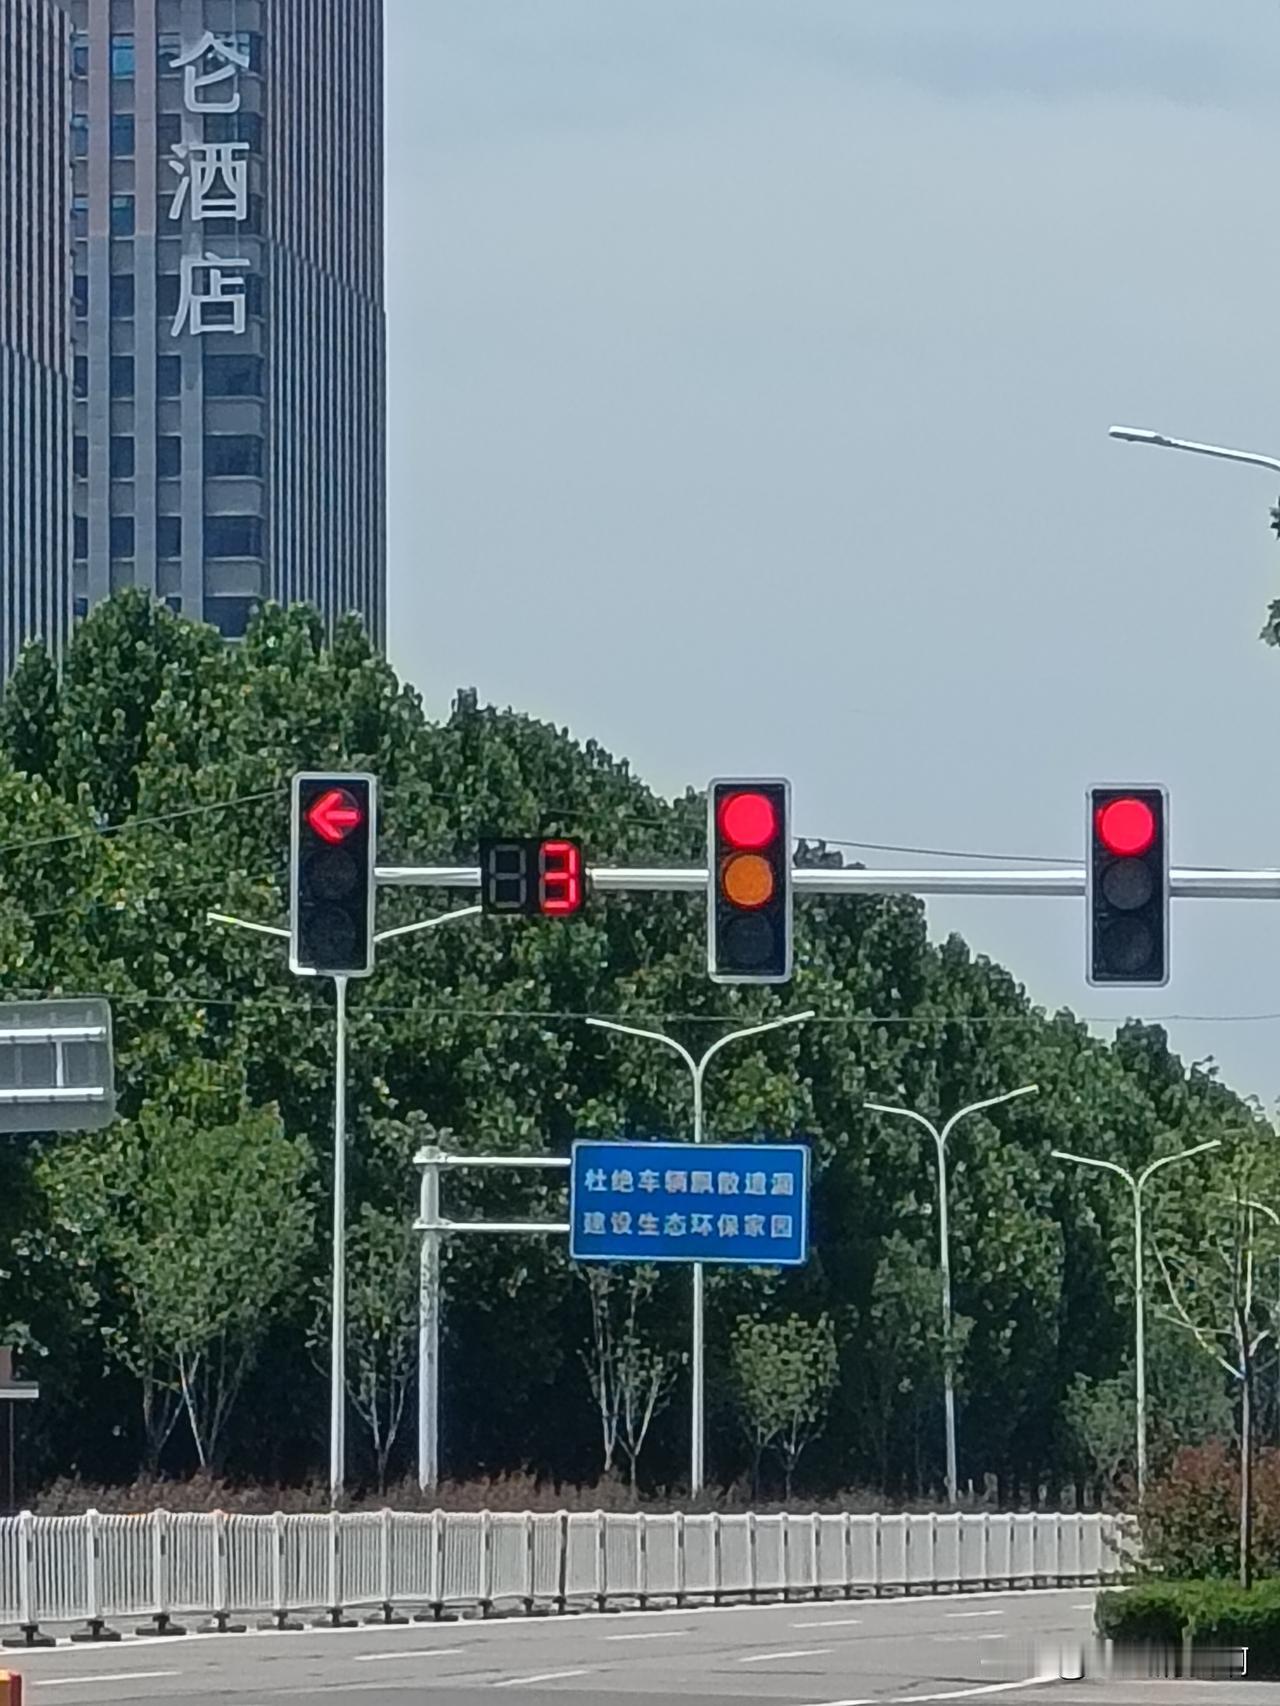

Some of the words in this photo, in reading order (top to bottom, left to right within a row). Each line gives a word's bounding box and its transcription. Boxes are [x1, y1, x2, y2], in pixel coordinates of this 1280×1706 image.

[168, 31, 250, 337] 仑酒店
[583, 1211, 793, 1238] 建设生态环保家园
